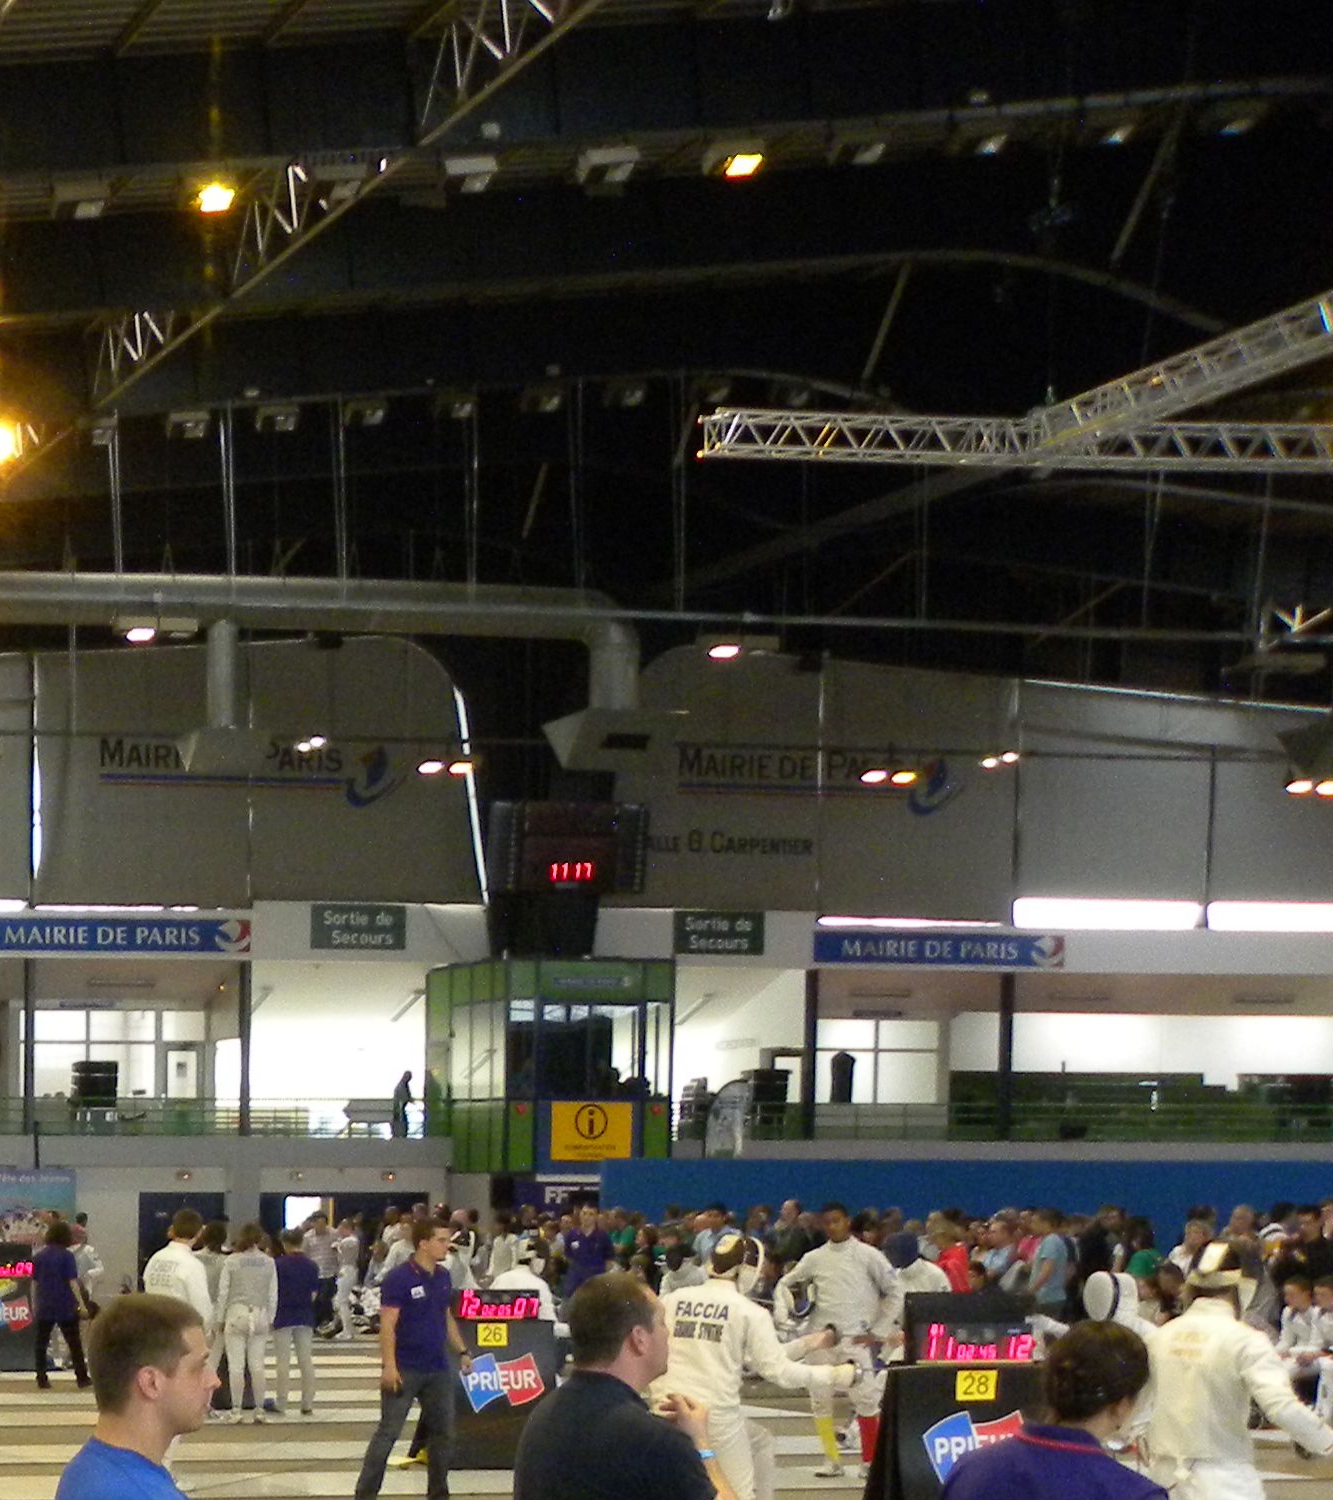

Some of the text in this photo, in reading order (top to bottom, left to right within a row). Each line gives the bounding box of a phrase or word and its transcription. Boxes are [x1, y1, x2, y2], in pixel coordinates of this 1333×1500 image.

[99, 738, 185, 770] MAIRI
[677, 746, 772, 779] MAIRIE
[779, 754, 814, 780] DE
[710, 831, 814, 856] CARPENTIER
[323, 909, 394, 926] Sortie de
[685, 916, 753, 932] Sortie de
[4, 925, 201, 946] MAIRIE DE PARIS
[331, 929, 394, 945] Secours
[689, 934, 749, 950] Secours
[841, 938, 1019, 960] MAIRIE DE PARIS
[675, 1300, 729, 1321] FACCIA
[482, 1326, 503, 1343] 26
[1008, 1334, 1033, 1360] 12
[467, 1369, 538, 1392] PRIEUR
[962, 1373, 990, 1396] 28
[934, 1433, 1014, 1464] PRIE
